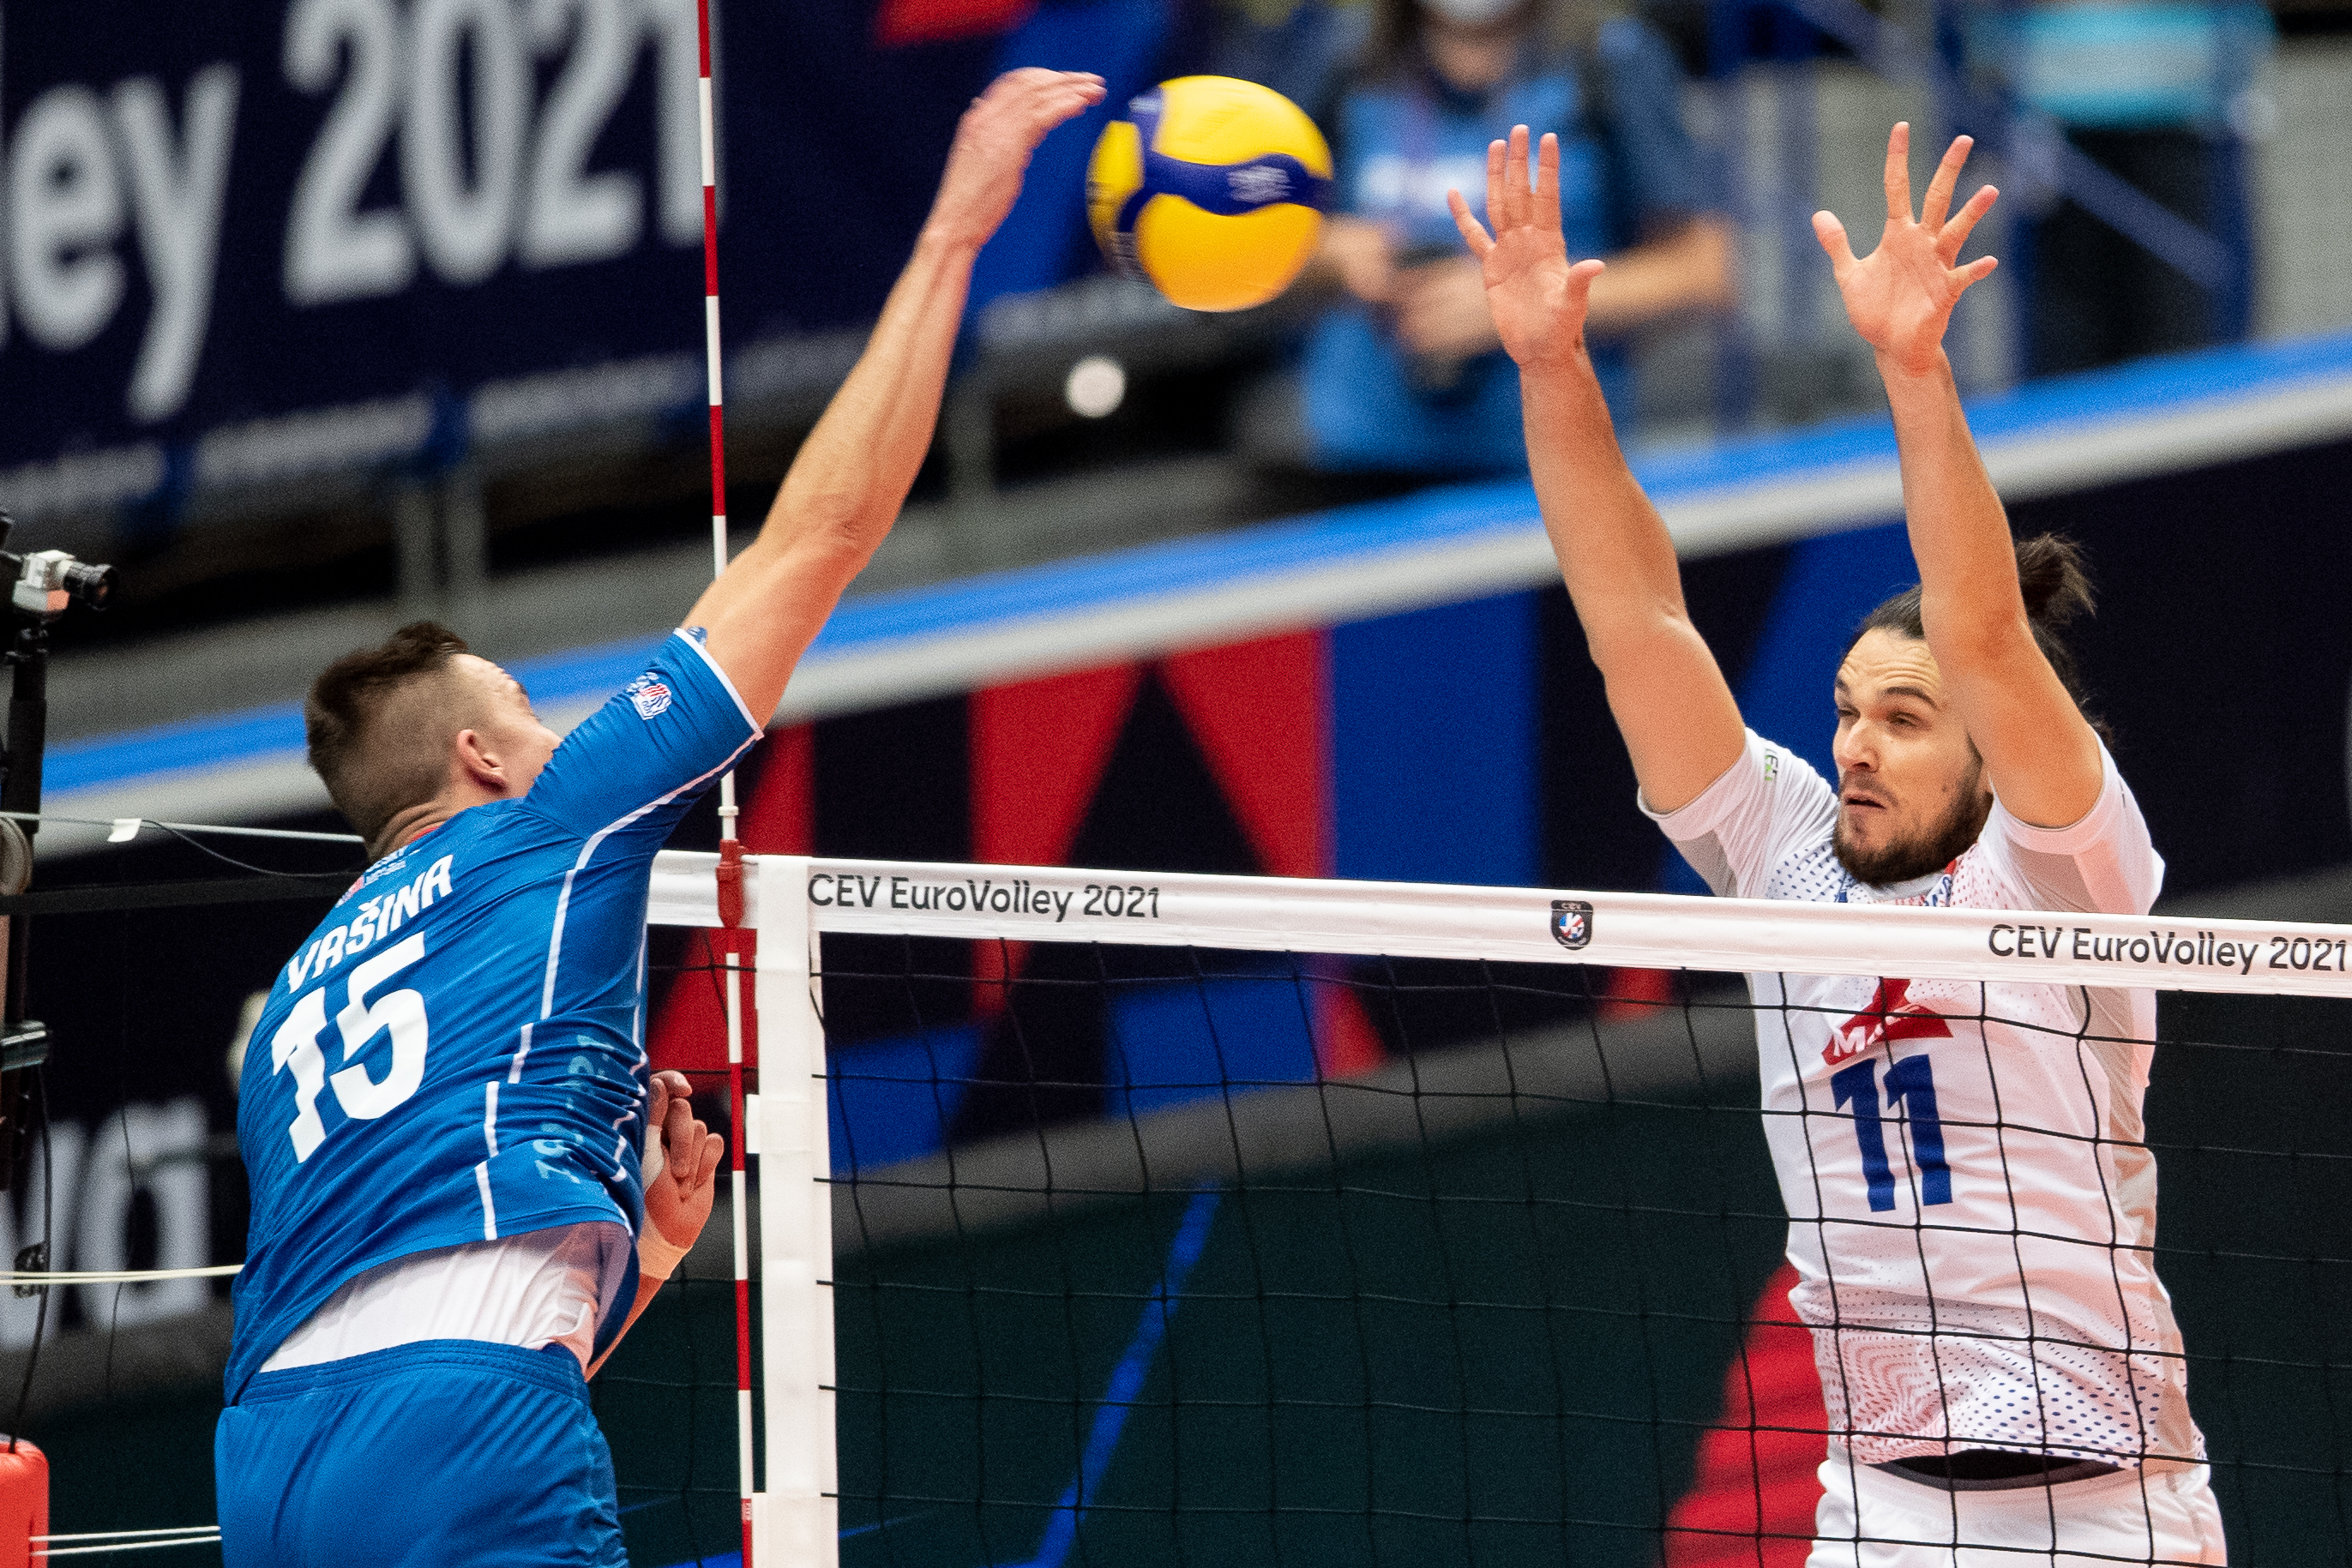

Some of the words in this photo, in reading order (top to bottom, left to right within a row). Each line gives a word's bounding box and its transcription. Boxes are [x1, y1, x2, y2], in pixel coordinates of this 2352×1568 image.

[0, 60, 242, 424] ey
[281, 0, 722, 305] 2021
[287, 854, 454, 994] VAŠINA
[808, 873, 881, 908] CEV
[891, 876, 1074, 922] EuroVolley
[1083, 884, 1160, 918] 2021
[1988, 923, 2063, 958] CEV
[2072, 927, 2260, 976] EuroVolley
[2269, 936, 2347, 972] 2021
[271, 930, 429, 1164] 15
[1831, 1054, 1953, 1213] 11
